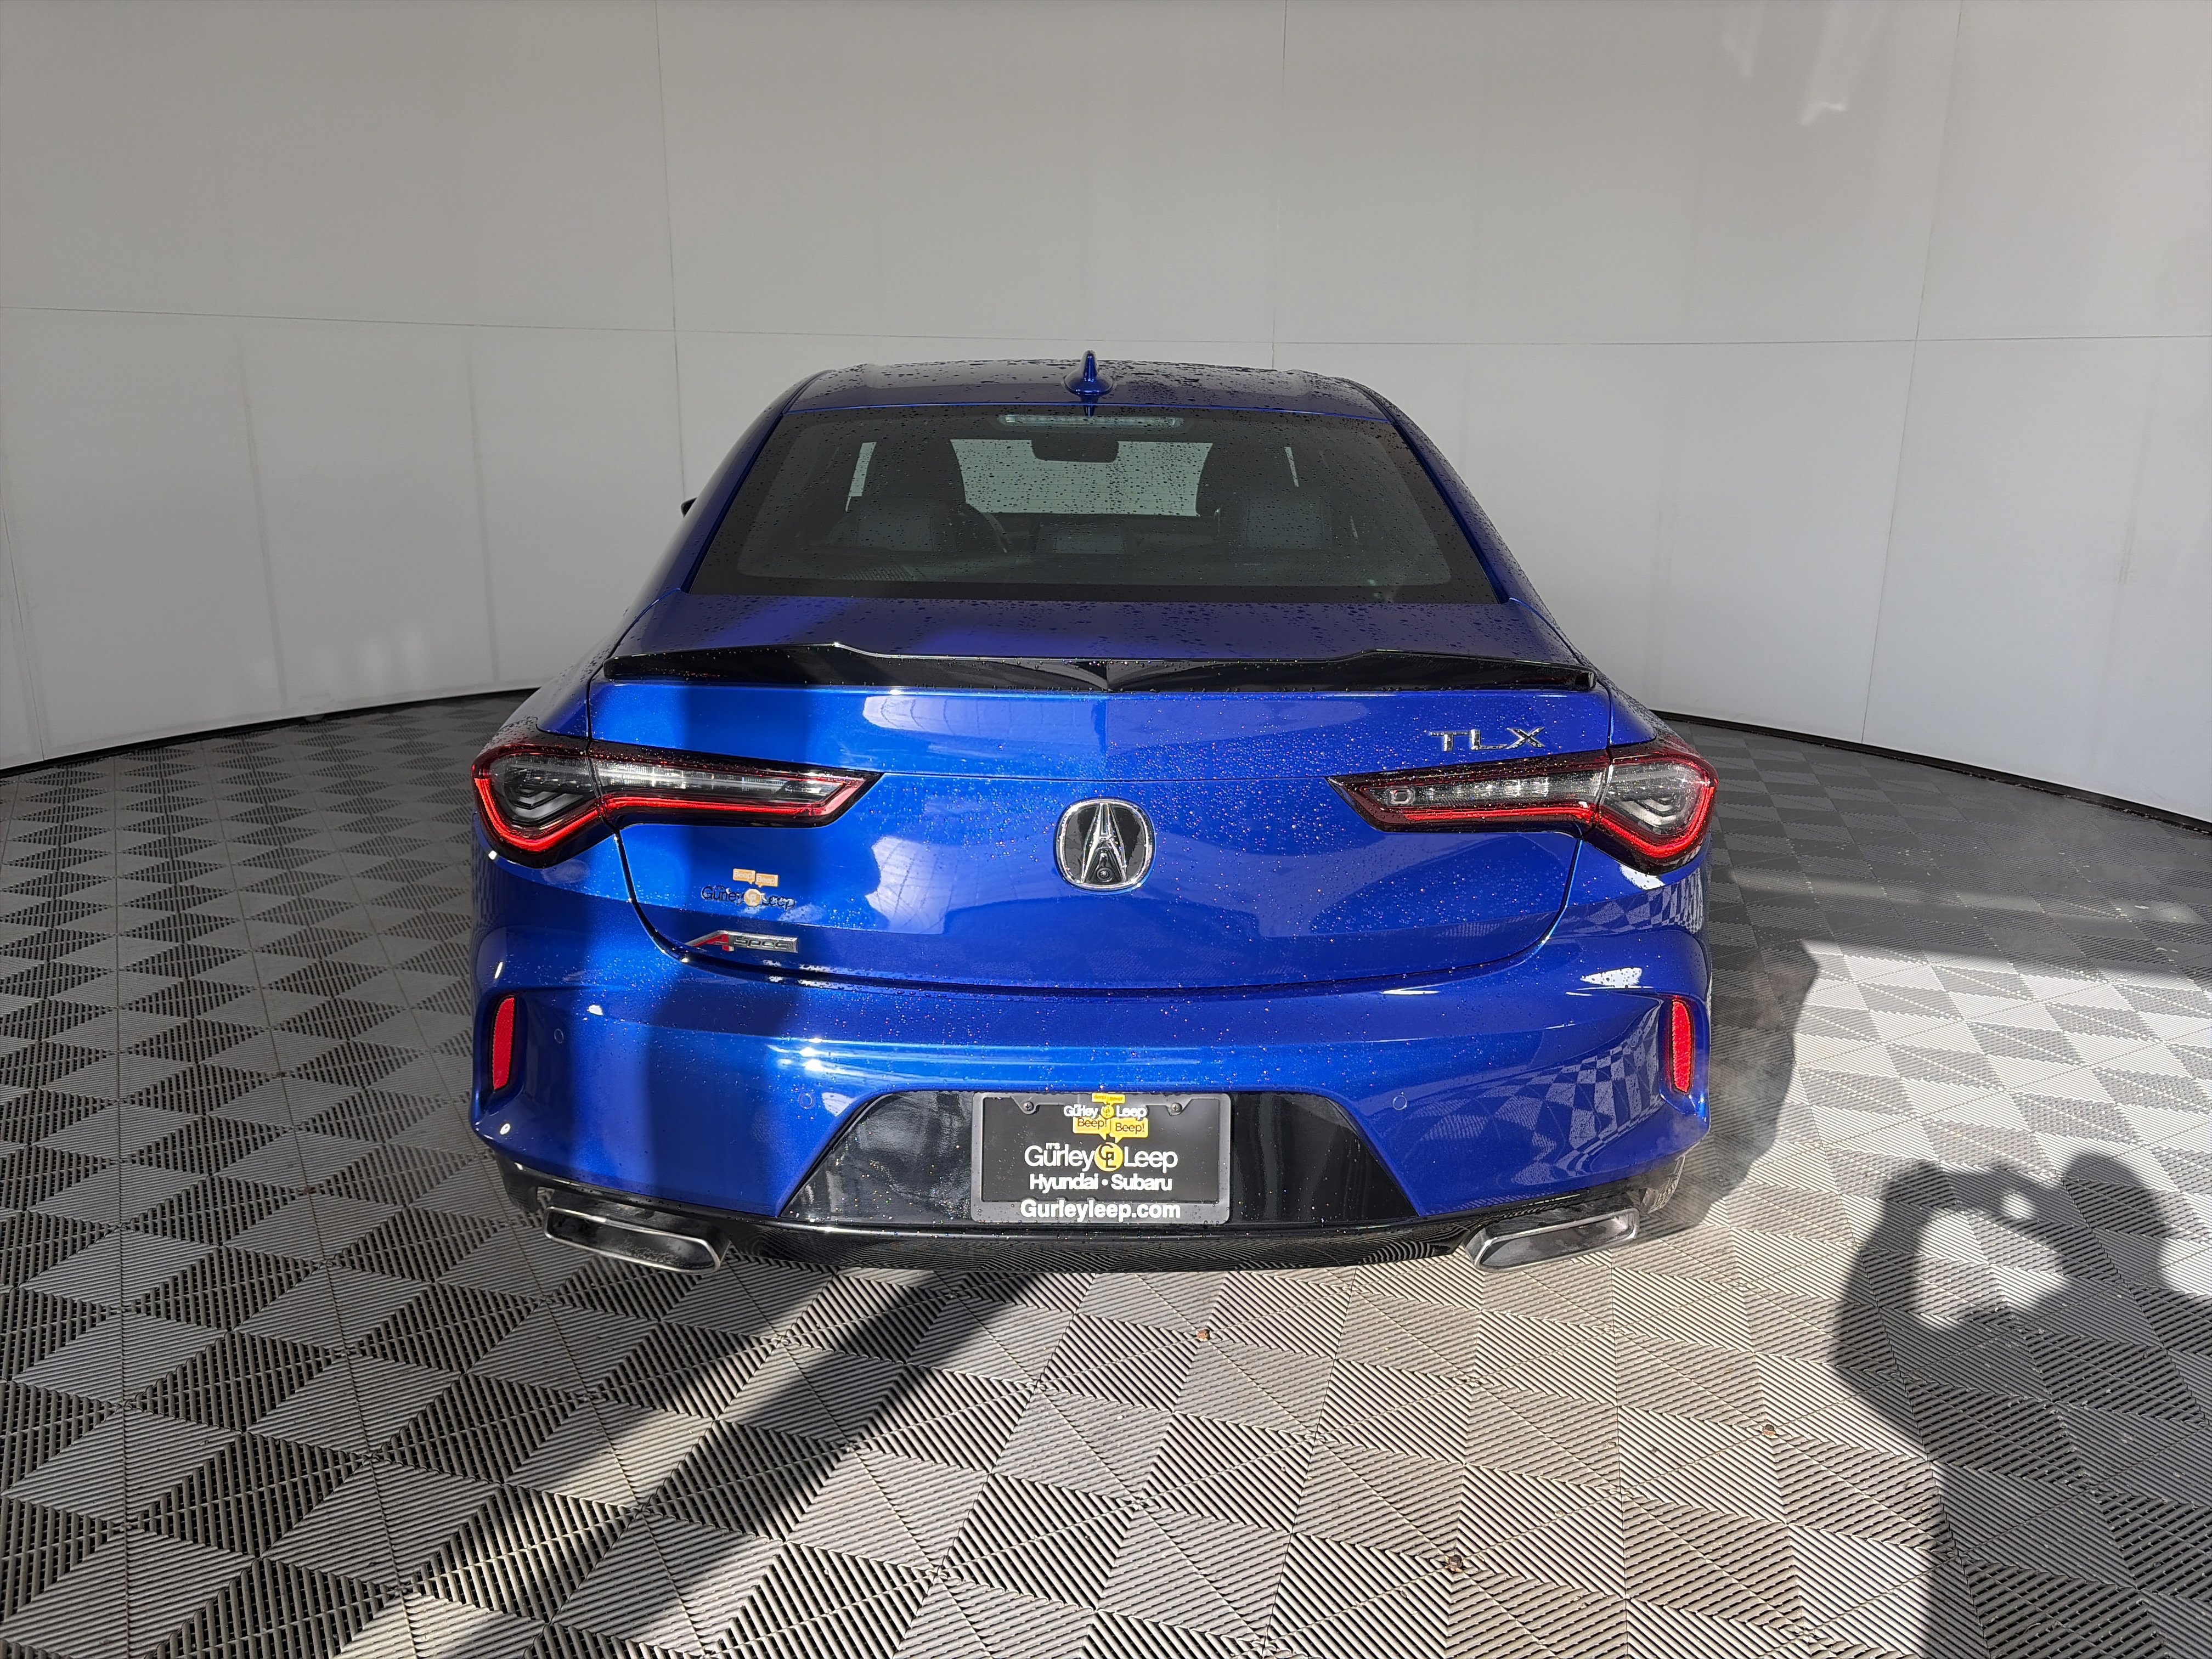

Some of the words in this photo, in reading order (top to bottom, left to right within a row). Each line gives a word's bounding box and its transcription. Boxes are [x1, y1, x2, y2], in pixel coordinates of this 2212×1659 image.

[1429, 726, 1546, 752] TLX
[1063, 1104, 1098, 1119] Gurley
[1116, 1105, 1147, 1120] Leep
[1077, 1118, 1107, 1130] Beep!
[1115, 1122, 1145, 1135] Beep!
[1024, 1144, 1095, 1172] Gurley
[1124, 1147, 1178, 1173] Leep
[1029, 1173, 1099, 1194] Hyundai
[1110, 1173, 1172, 1191] Subaru
[1020, 1199, 1181, 1222] Gurleyleep.com
